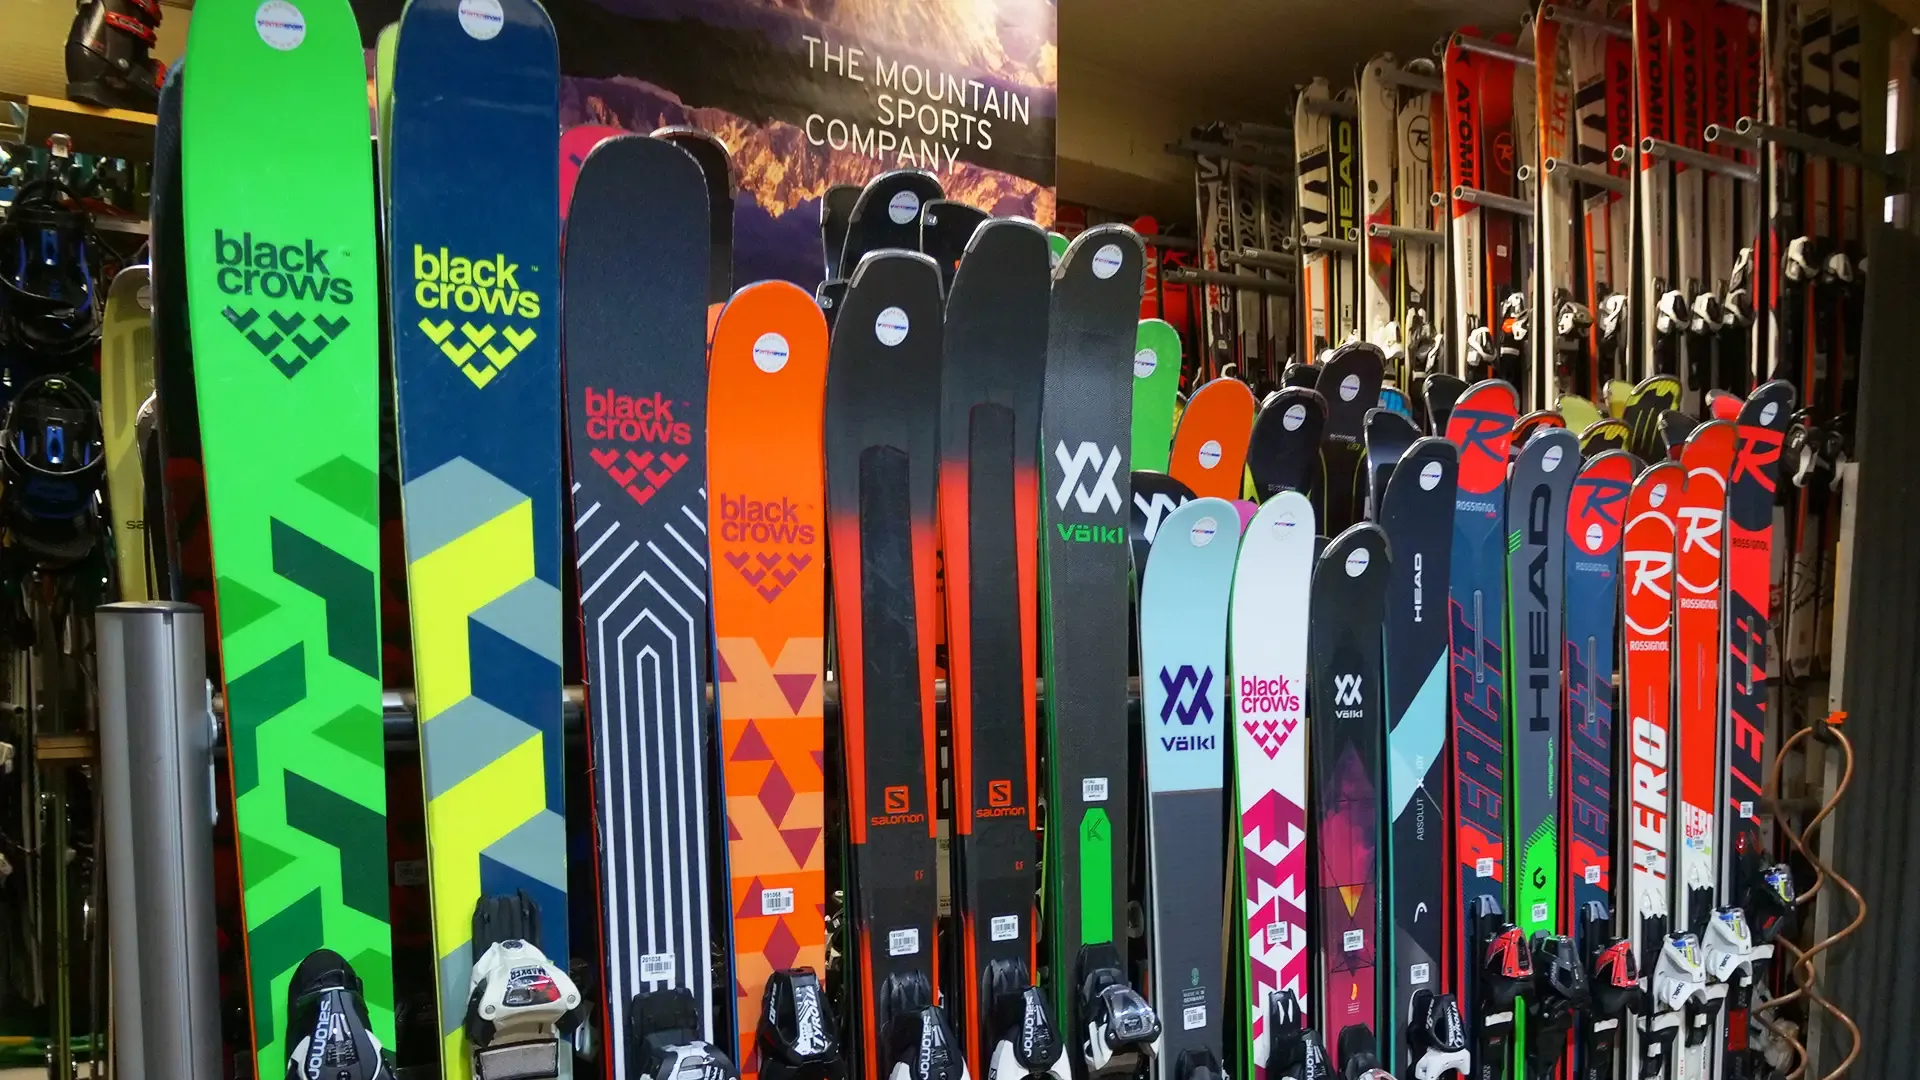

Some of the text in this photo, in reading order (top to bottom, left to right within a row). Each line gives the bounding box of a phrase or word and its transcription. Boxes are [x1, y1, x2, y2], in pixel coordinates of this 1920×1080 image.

[802, 35, 1030, 126] THE MOUNTAIN
[877, 94, 993, 151] SPORTS
[805, 113, 960, 175] COMPANY
[215, 229, 329, 275] black
[414, 244, 519, 289] black
[217, 264, 354, 305] crows
[415, 280, 540, 319] crows
[585, 386, 672, 421] black
[586, 416, 692, 445] crows
[720, 493, 798, 524] black
[1456, 500, 1497, 513] ROSSIGNOL
[721, 521, 815, 545] crows
[1056, 522, 1124, 545] Völkl
[1731, 537, 1769, 551] ROSSIGNOL
[1413, 552, 1423, 623] HEAD
[1681, 597, 1718, 609] ROSSIGNOL
[1529, 484, 1552, 732] HEAD
[1629, 640, 1670, 651] ROSSIGNOL
[1241, 675, 1290, 697] black
[1241, 694, 1300, 713] crows
[1335, 708, 1363, 718] Völkl
[1160, 734, 1216, 752] Völkl
[975, 806, 1026, 819] salomon
[1631, 716, 1668, 880] HERO
[871, 812, 924, 826] salomon
[1415, 797, 1425, 841] ABSOLUT
[807, 985, 826, 1050] TYROLIA
[309, 998, 332, 1080] salomon
